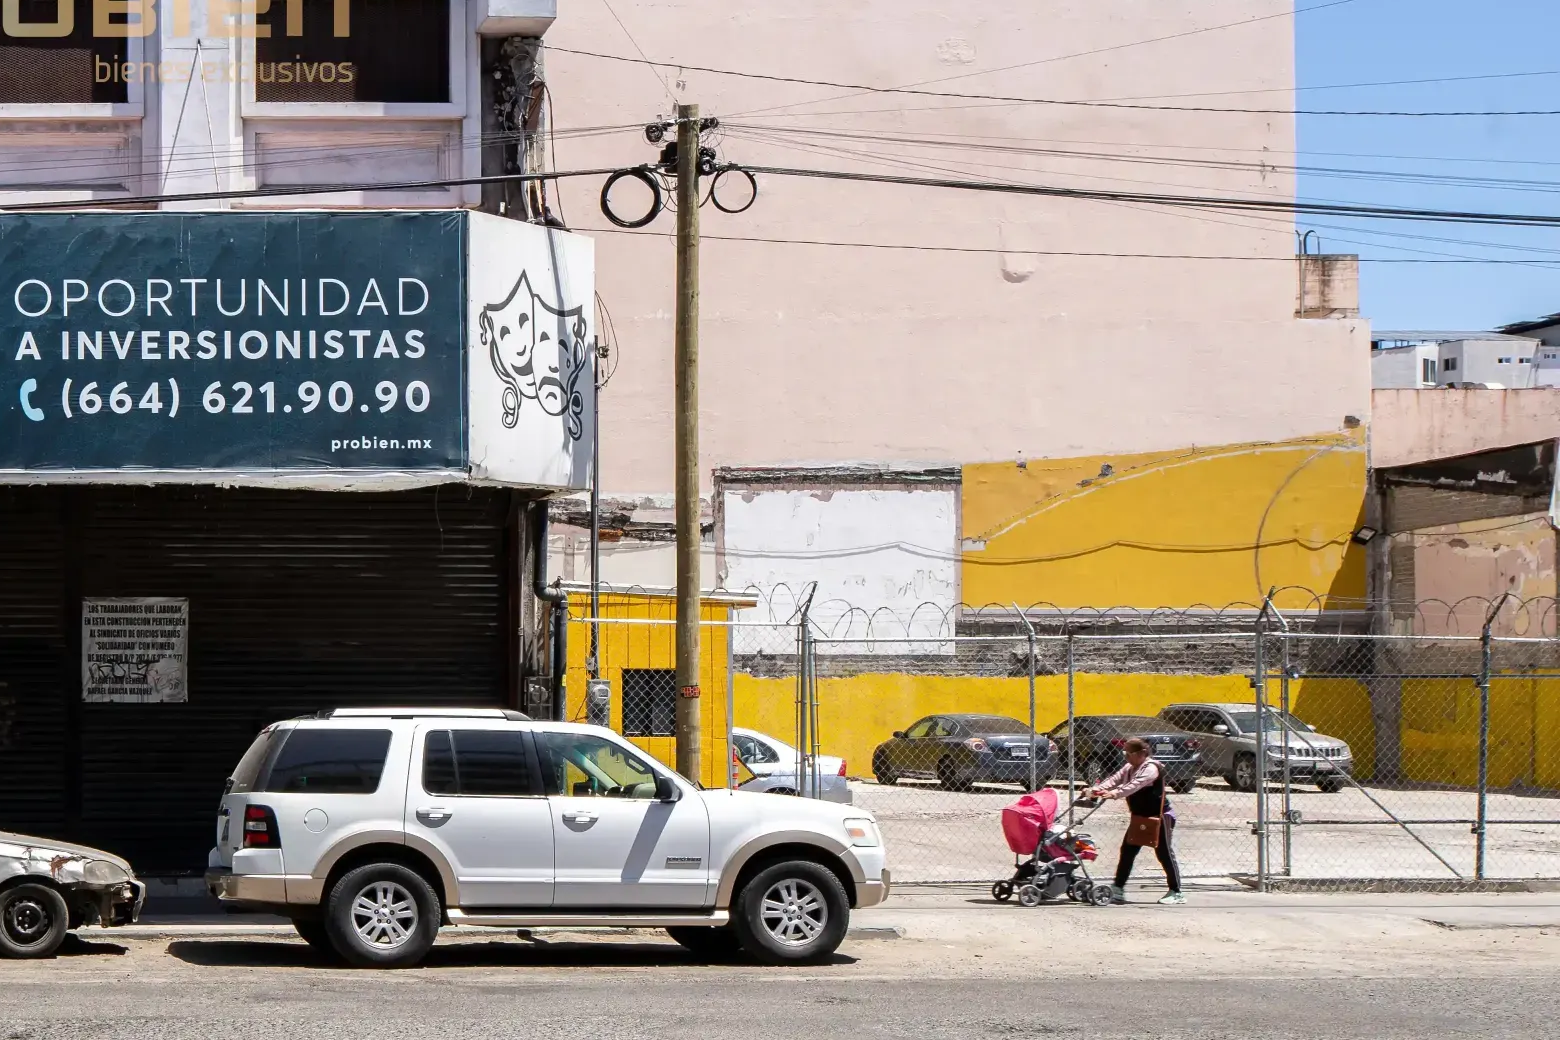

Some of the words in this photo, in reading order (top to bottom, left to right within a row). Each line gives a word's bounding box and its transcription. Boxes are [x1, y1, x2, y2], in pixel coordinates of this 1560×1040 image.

[13, 276, 430, 317] OPORTUNIDAD
[14, 330, 42, 361] A
[61, 328, 426, 360] INVERSIONISTAS
[61, 377, 181, 418] (664)
[202, 379, 430, 415] 621.90.90
[331, 435, 432, 453] probien.mx
[88, 605, 99, 614] LOS
[100, 605, 143, 613] TRABAJADORES
[144, 605, 155, 614] QUE
[156, 605, 182, 613] LABORAN
[84, 617, 91, 626] EN
[92, 617, 105, 626] ESTA
[152, 617, 186, 626] PERTENECEN
[89, 629, 96, 638] AL
[97, 629, 127, 638] SINDICATO
[128, 629, 135, 638] DE
[136, 629, 159, 638] OFICIOS
[159, 629, 181, 638] VARIOS
[139, 641, 151, 650] CON
[88, 654, 95, 662] DE
[88, 687, 106, 695] RAFAEL
